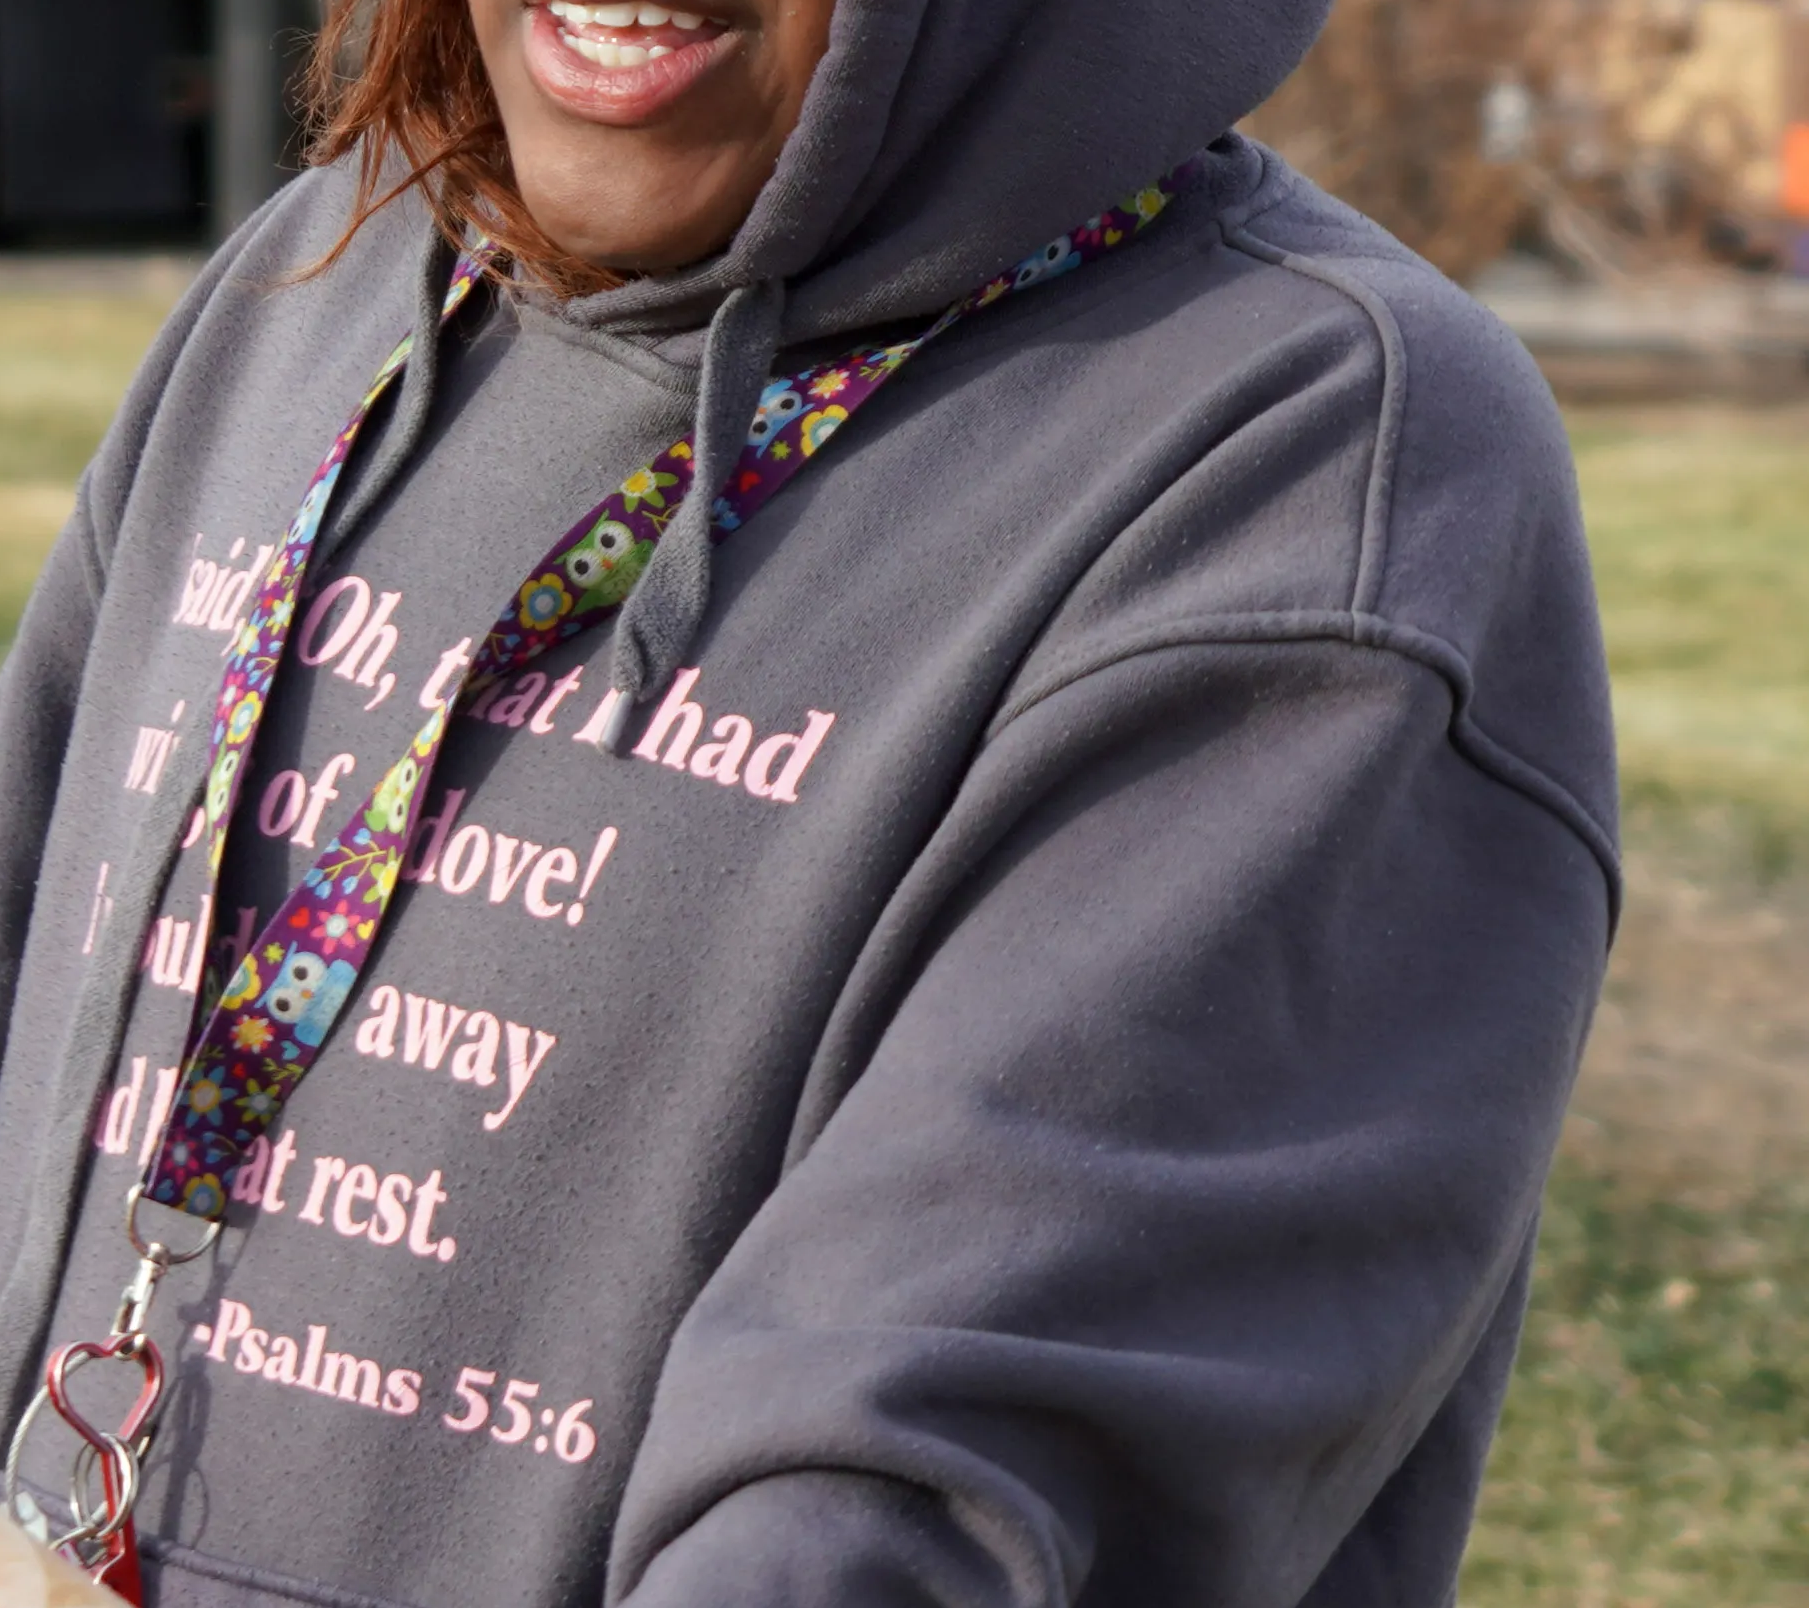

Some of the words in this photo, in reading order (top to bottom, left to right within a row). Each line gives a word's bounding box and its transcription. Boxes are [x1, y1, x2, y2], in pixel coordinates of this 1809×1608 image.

[297, 574, 402, 711] Oh,
[632, 665, 836, 803] had
[258, 752, 355, 849] of
[403, 787, 619, 927] dove!
[354, 984, 557, 1131] away
[232, 1129, 297, 1213] at
[297, 1155, 457, 1262] rest.
[193, 1297, 423, 1416] -Psalms
[443, 1366, 597, 1463] 55:6
